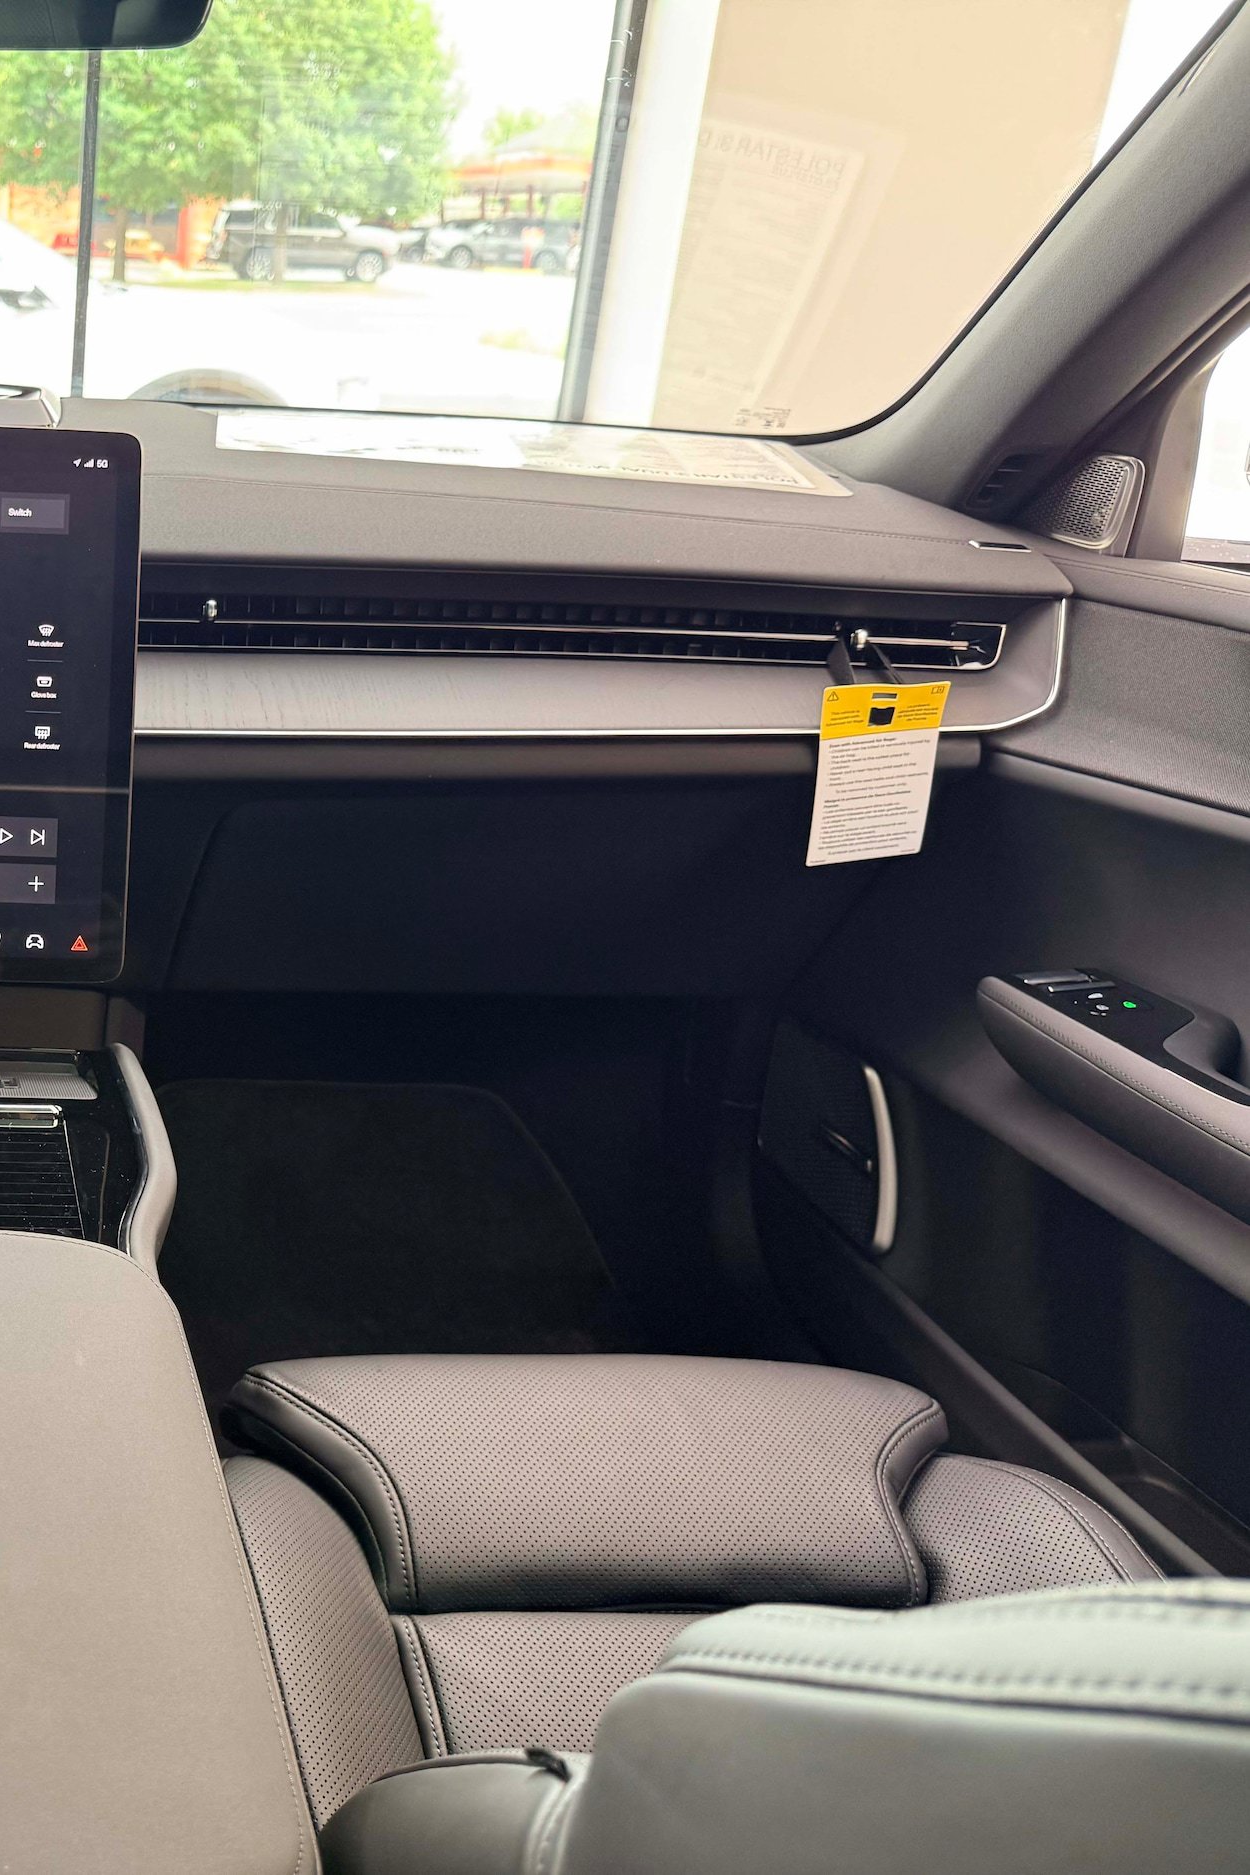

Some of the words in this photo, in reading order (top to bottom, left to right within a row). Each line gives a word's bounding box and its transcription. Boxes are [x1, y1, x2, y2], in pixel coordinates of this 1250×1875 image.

[8, 507, 33, 517] Switch
[31, 691, 46, 699] Glove
[46, 691, 57, 699] box
